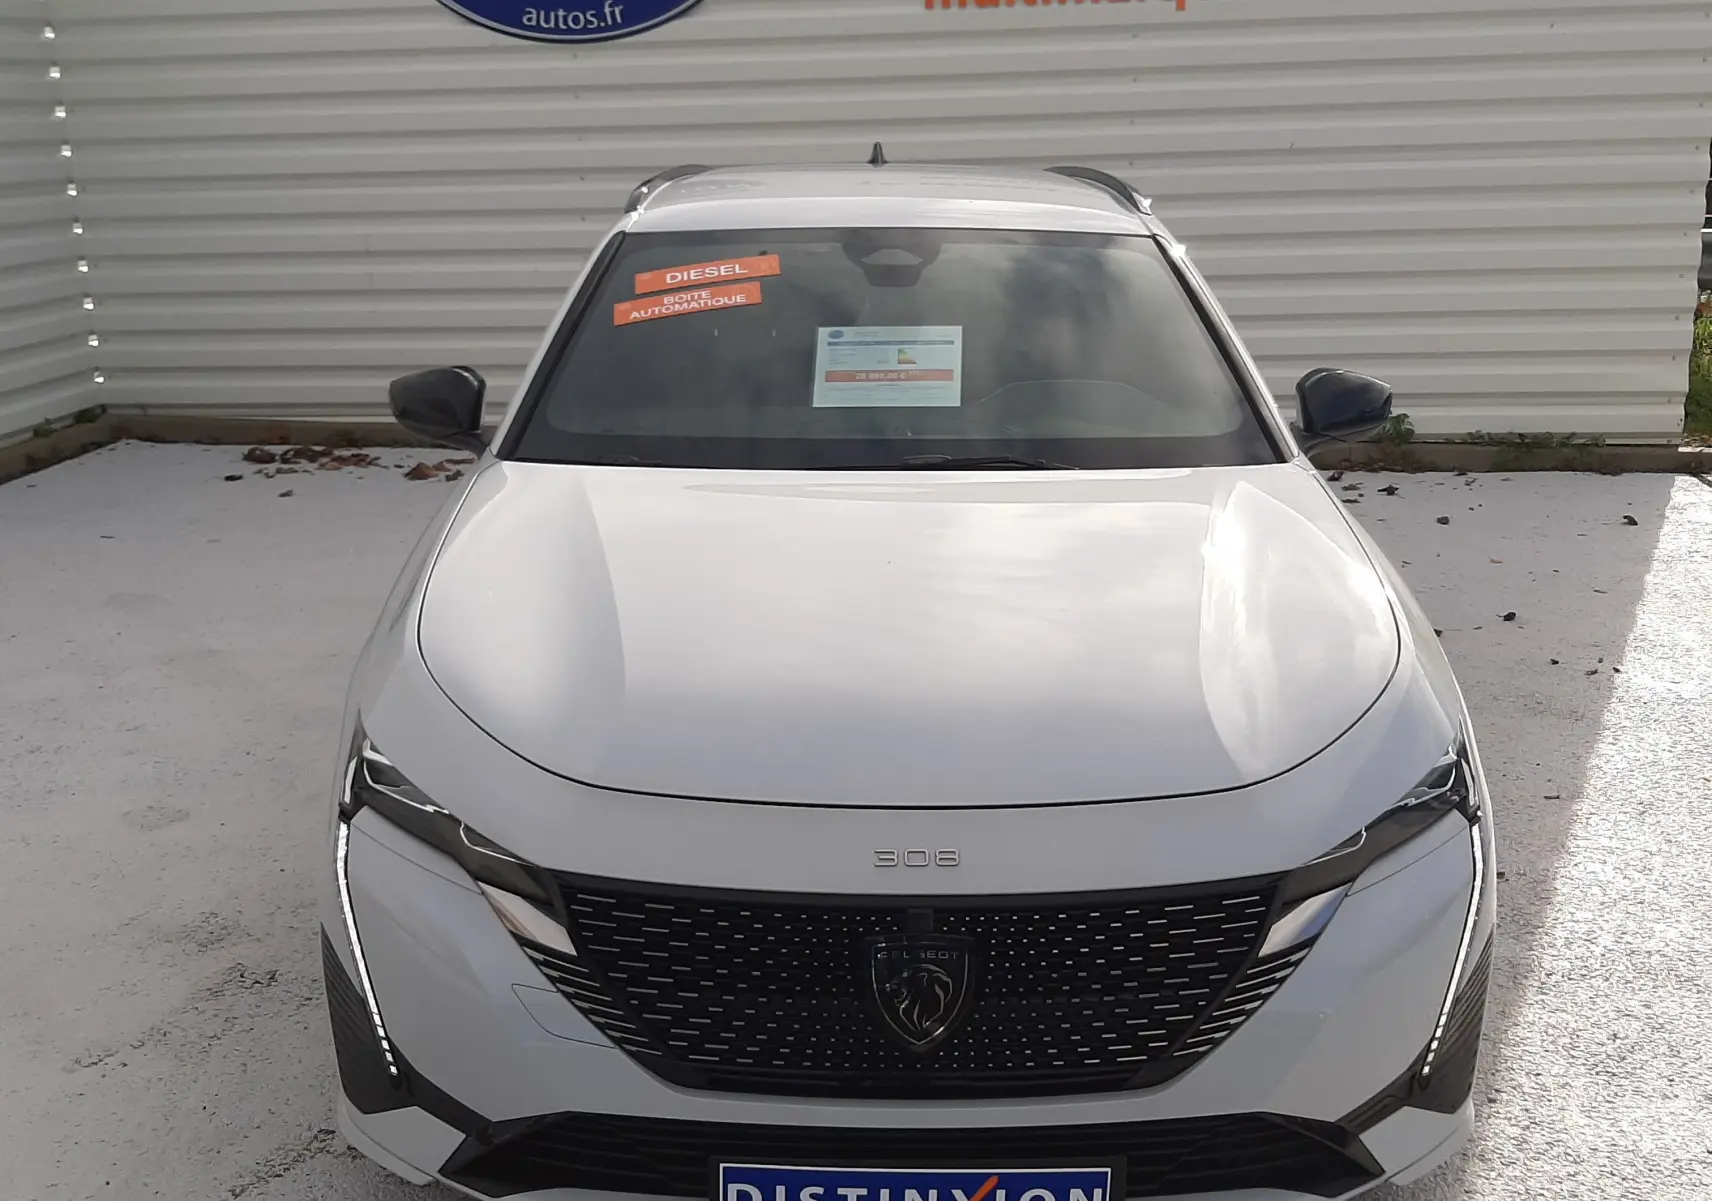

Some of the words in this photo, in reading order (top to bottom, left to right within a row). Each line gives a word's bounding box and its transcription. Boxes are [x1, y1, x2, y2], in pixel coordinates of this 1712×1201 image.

[522, 0, 624, 30] autos.fr
[665, 263, 749, 284] DIESEL
[629, 294, 747, 320] AUTOMATIQUE
[663, 290, 712, 305] BOITE
[872, 848, 961, 867] 308
